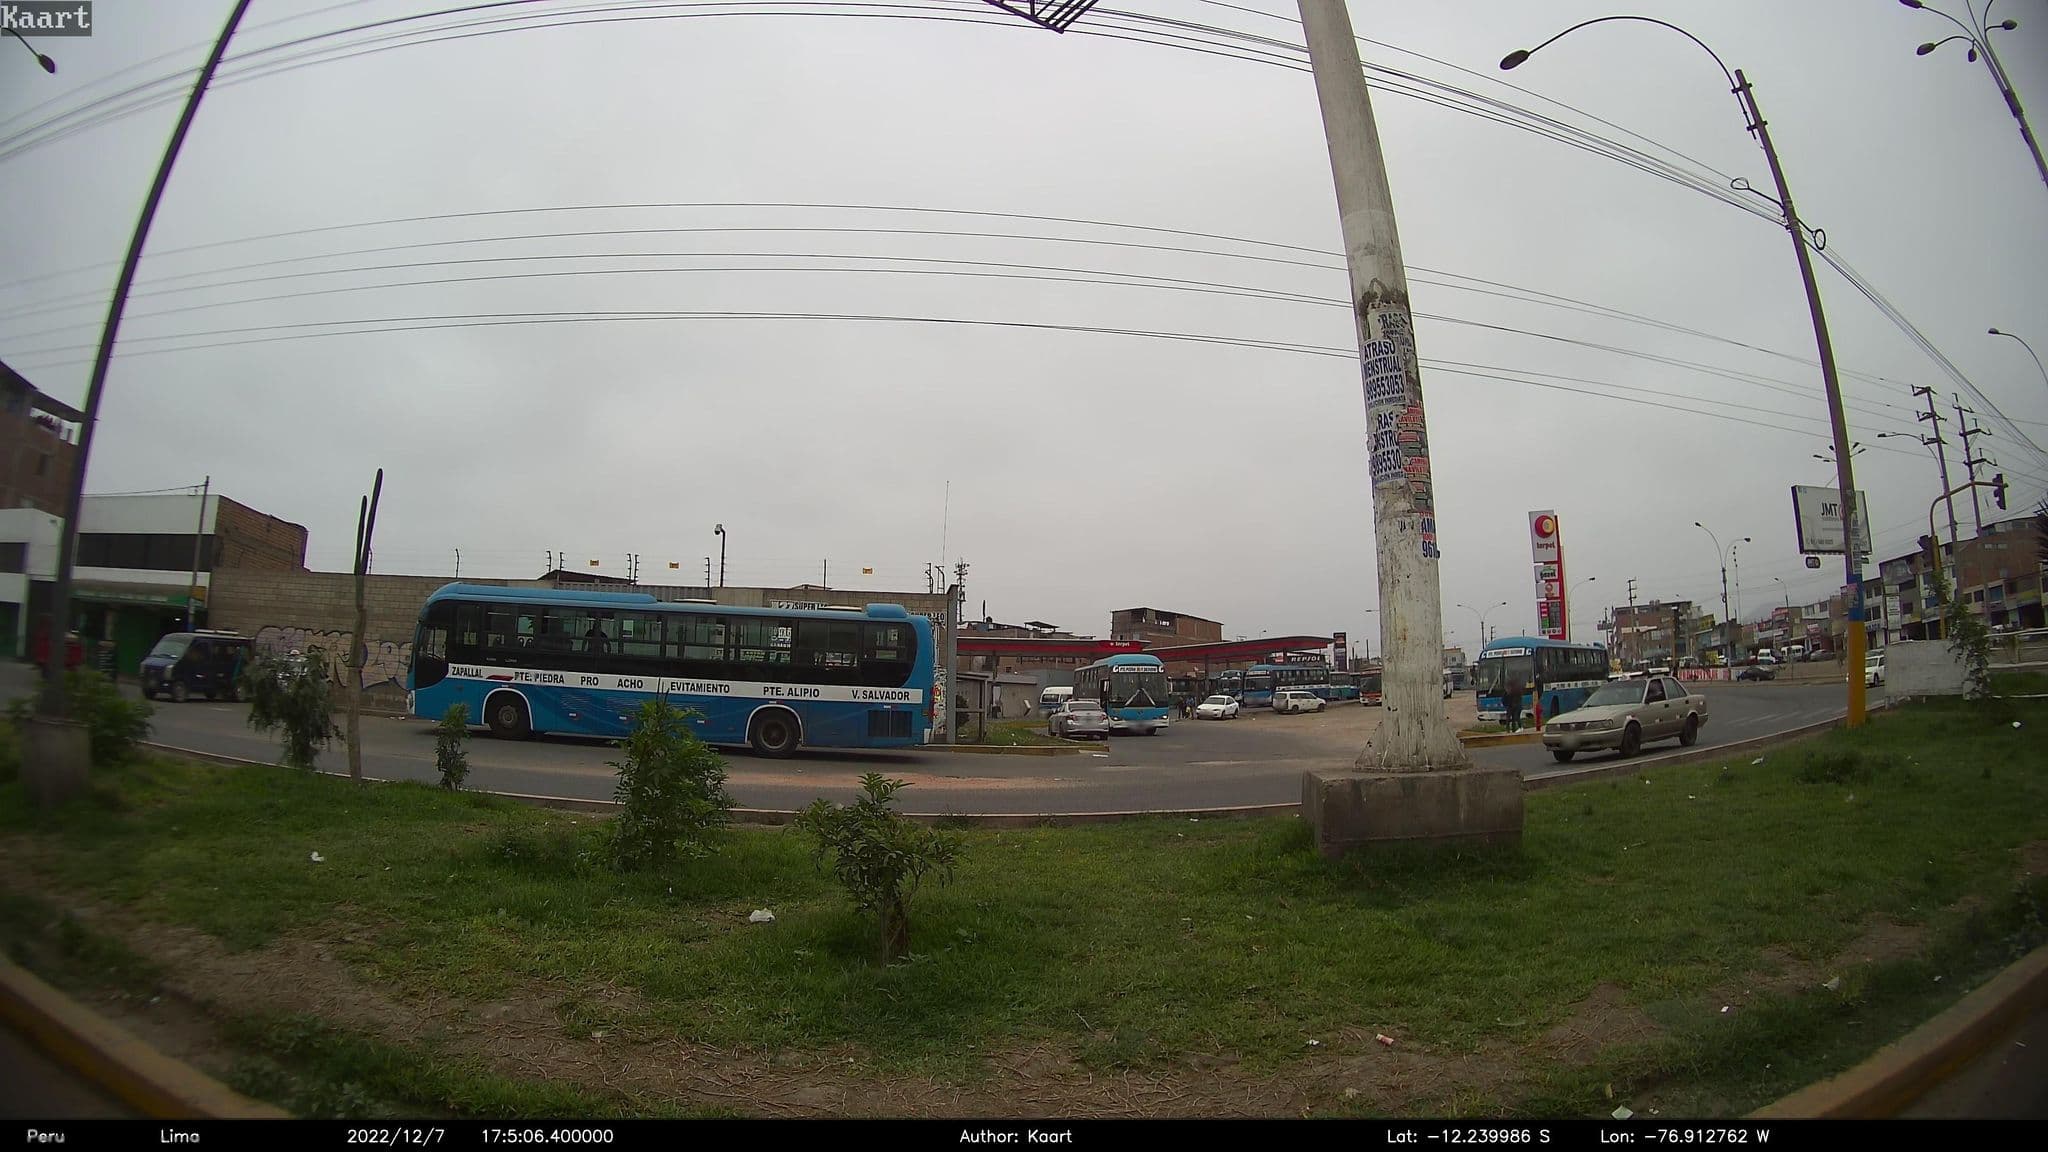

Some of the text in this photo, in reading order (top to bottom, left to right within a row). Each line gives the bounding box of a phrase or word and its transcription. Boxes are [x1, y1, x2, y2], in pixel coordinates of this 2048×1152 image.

[451, 666, 483, 678] ZAPALLAL
[534, 673, 565, 684] PIEDRA
[580, 676, 599, 686] PRO
[617, 678, 644, 689] ACHO
[670, 681, 730, 694] EVITAMIENTO
[763, 686, 785, 697] PTE.
[787, 687, 820, 698] ALIPIO
[852, 689, 860, 700] V.
[862, 690, 910, 701] SALVADOR
